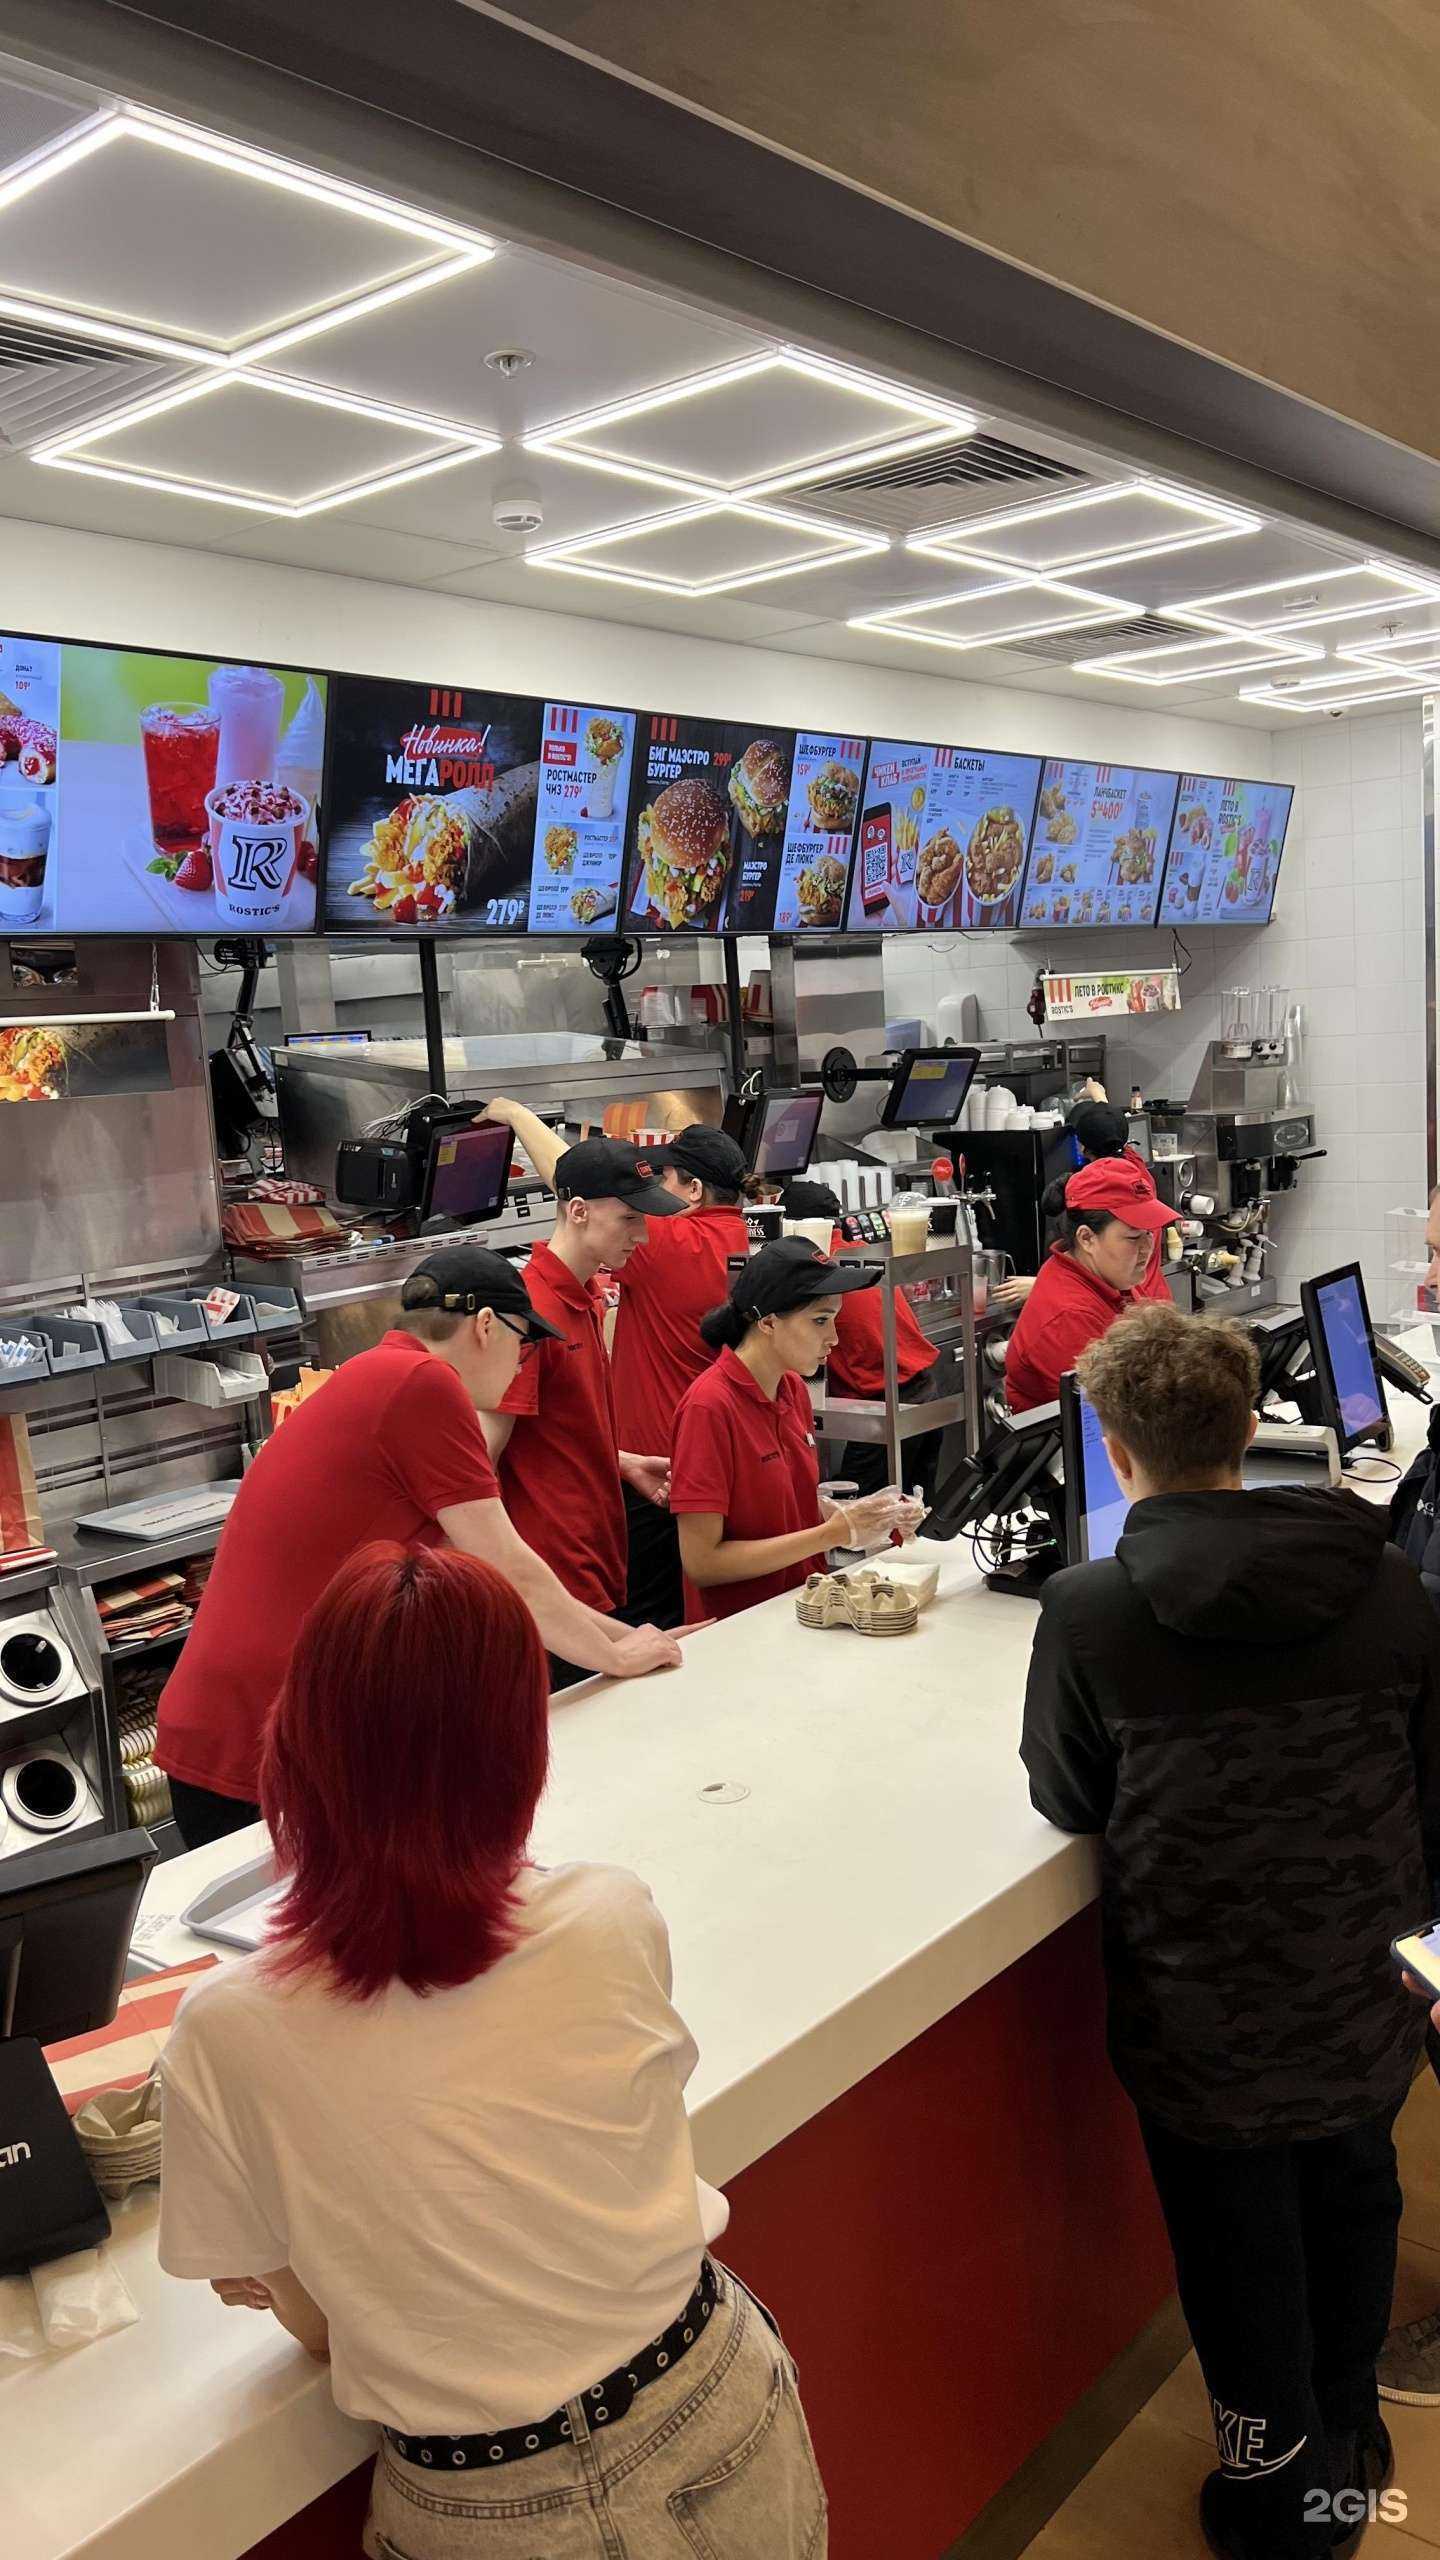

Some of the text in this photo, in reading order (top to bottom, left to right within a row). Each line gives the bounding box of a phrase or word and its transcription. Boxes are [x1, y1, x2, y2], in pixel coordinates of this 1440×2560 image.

[402, 723, 492, 759] Новинка!
[649, 746, 668, 762] БИГ
[668, 747, 710, 766] МАЭСТРО
[385, 754, 495, 790] МЕГАРОЛЛ
[647, 762, 682, 779] БУРГЕР
[953, 757, 985, 772] БАСКЕТЫ
[546, 769, 597, 784] РОСТМАСТЕР
[545, 783, 562, 795] ЧИЗ
[228, 835, 288, 891] R
[743, 861, 768, 871] МАЭСТРО
[742, 871, 762, 881] БУРГЕР
[228, 903, 280, 916] ROSTIC'S
[1074, 985, 1090, 998] ЛЕТО
[1091, 985, 1096, 996] В
